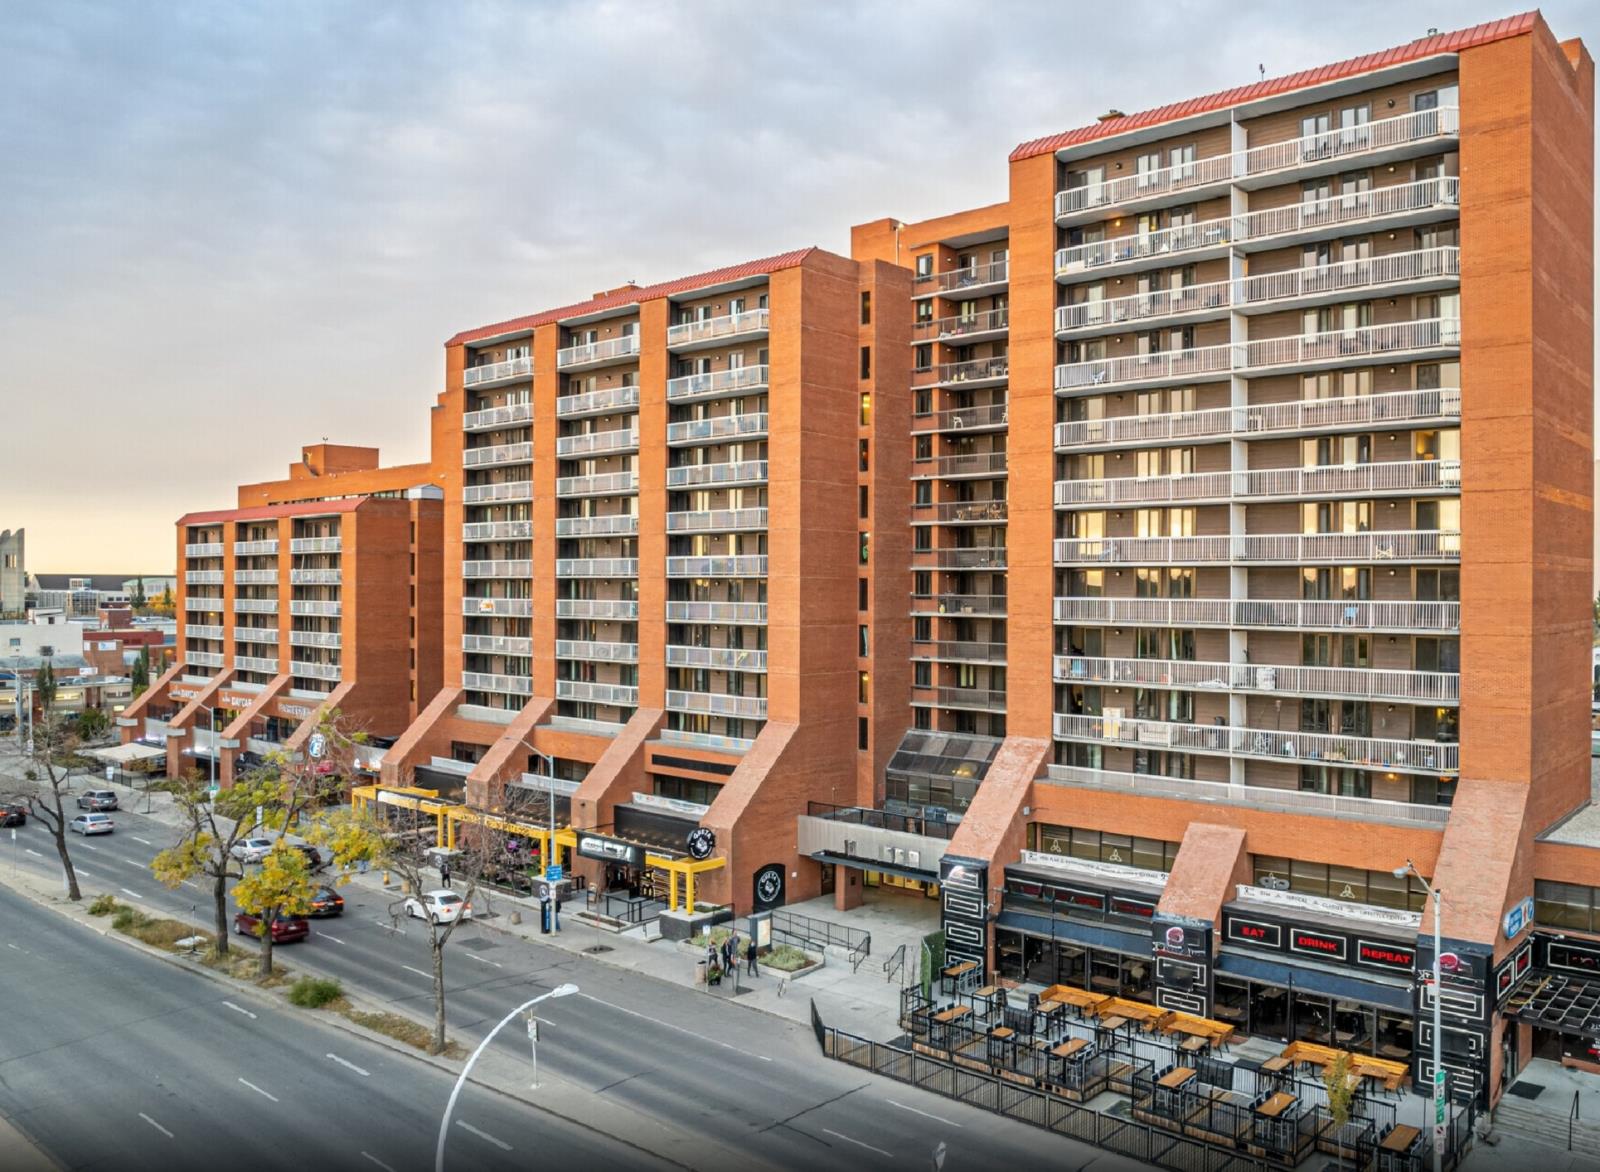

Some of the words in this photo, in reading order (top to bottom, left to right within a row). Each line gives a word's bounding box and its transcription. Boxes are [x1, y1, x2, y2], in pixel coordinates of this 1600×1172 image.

[1241, 926, 1265, 938] EAT
[1298, 936, 1337, 951] DRINK
[1361, 947, 1411, 964] REPEAT
